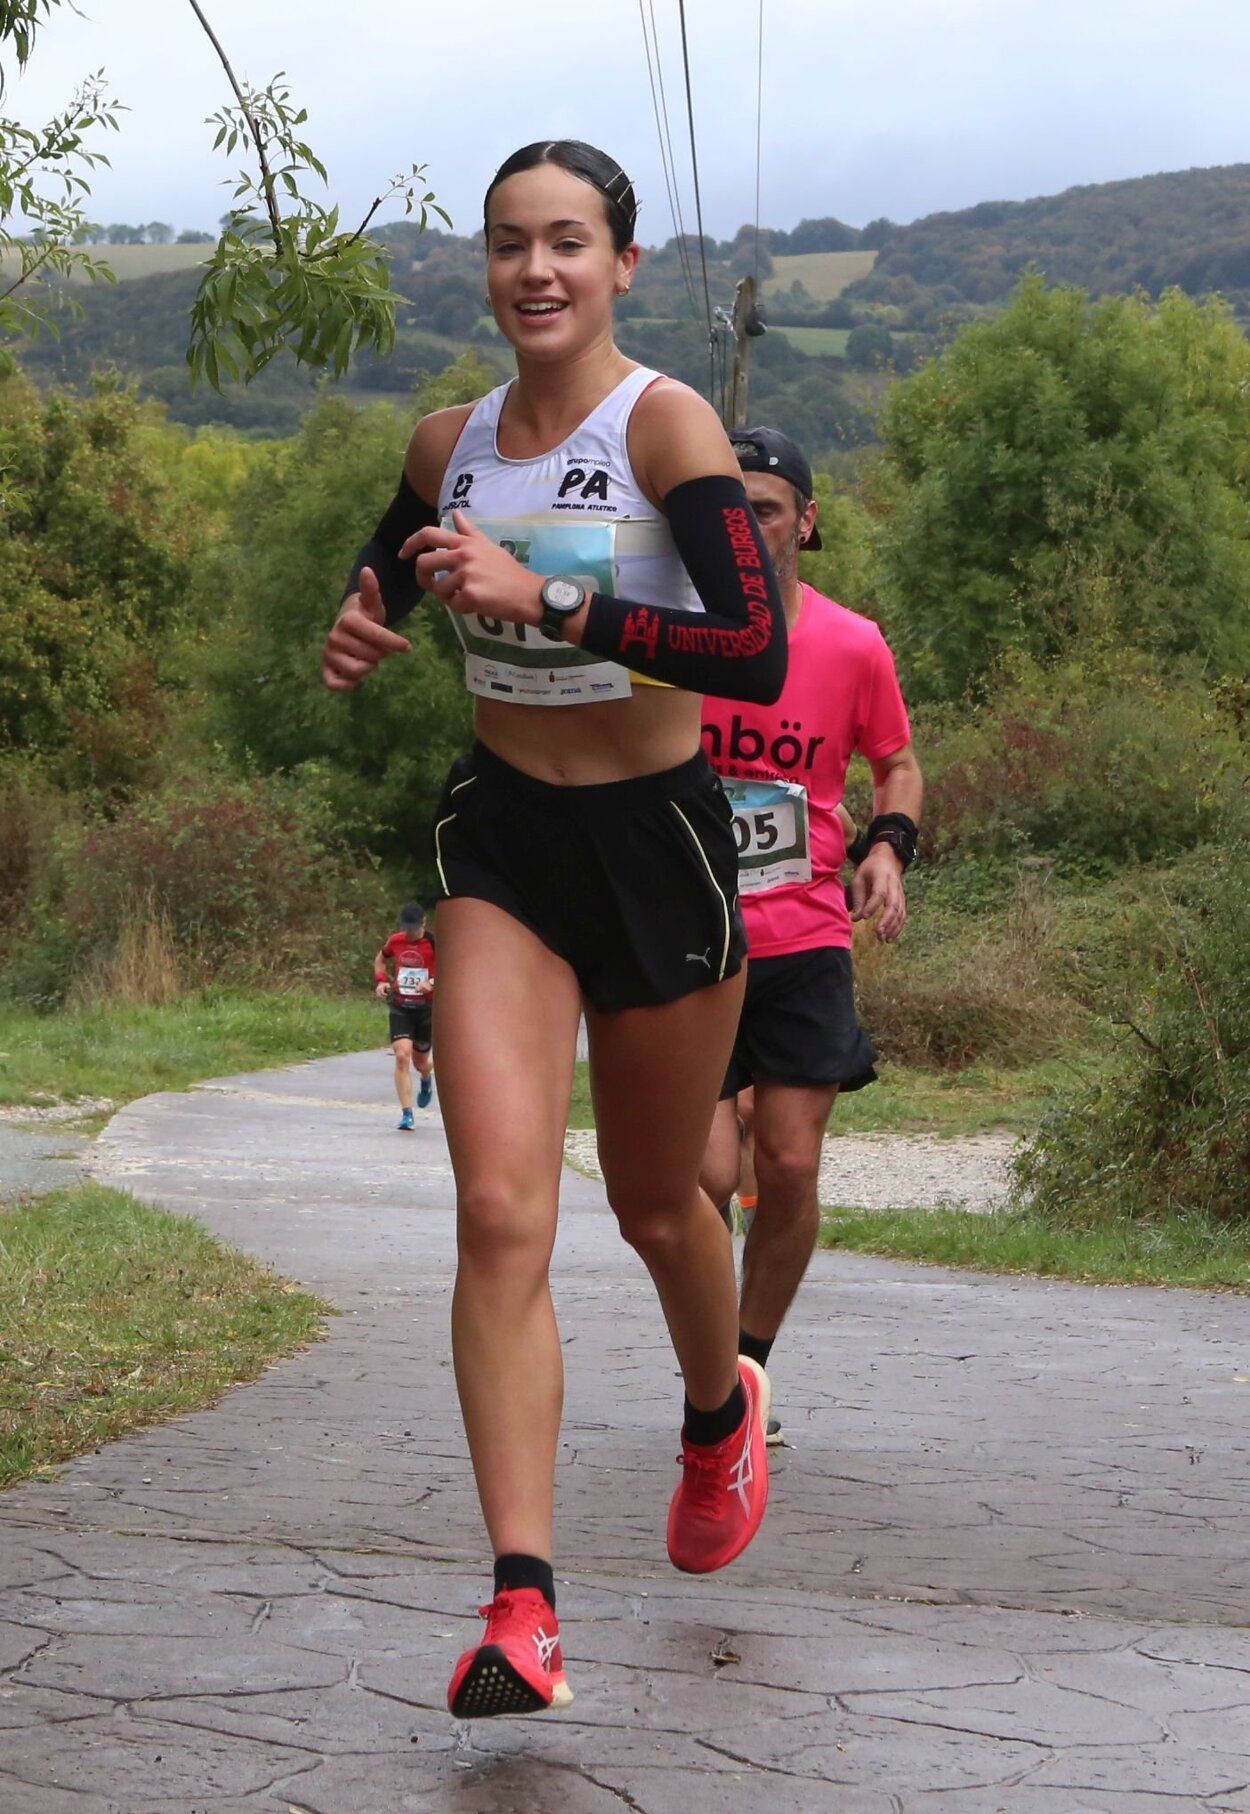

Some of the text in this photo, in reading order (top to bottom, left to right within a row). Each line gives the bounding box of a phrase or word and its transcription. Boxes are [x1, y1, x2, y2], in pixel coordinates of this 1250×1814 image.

[557, 468, 608, 501] PA
[668, 507, 772, 657] UNIVERSIDAD DE BURGOS
